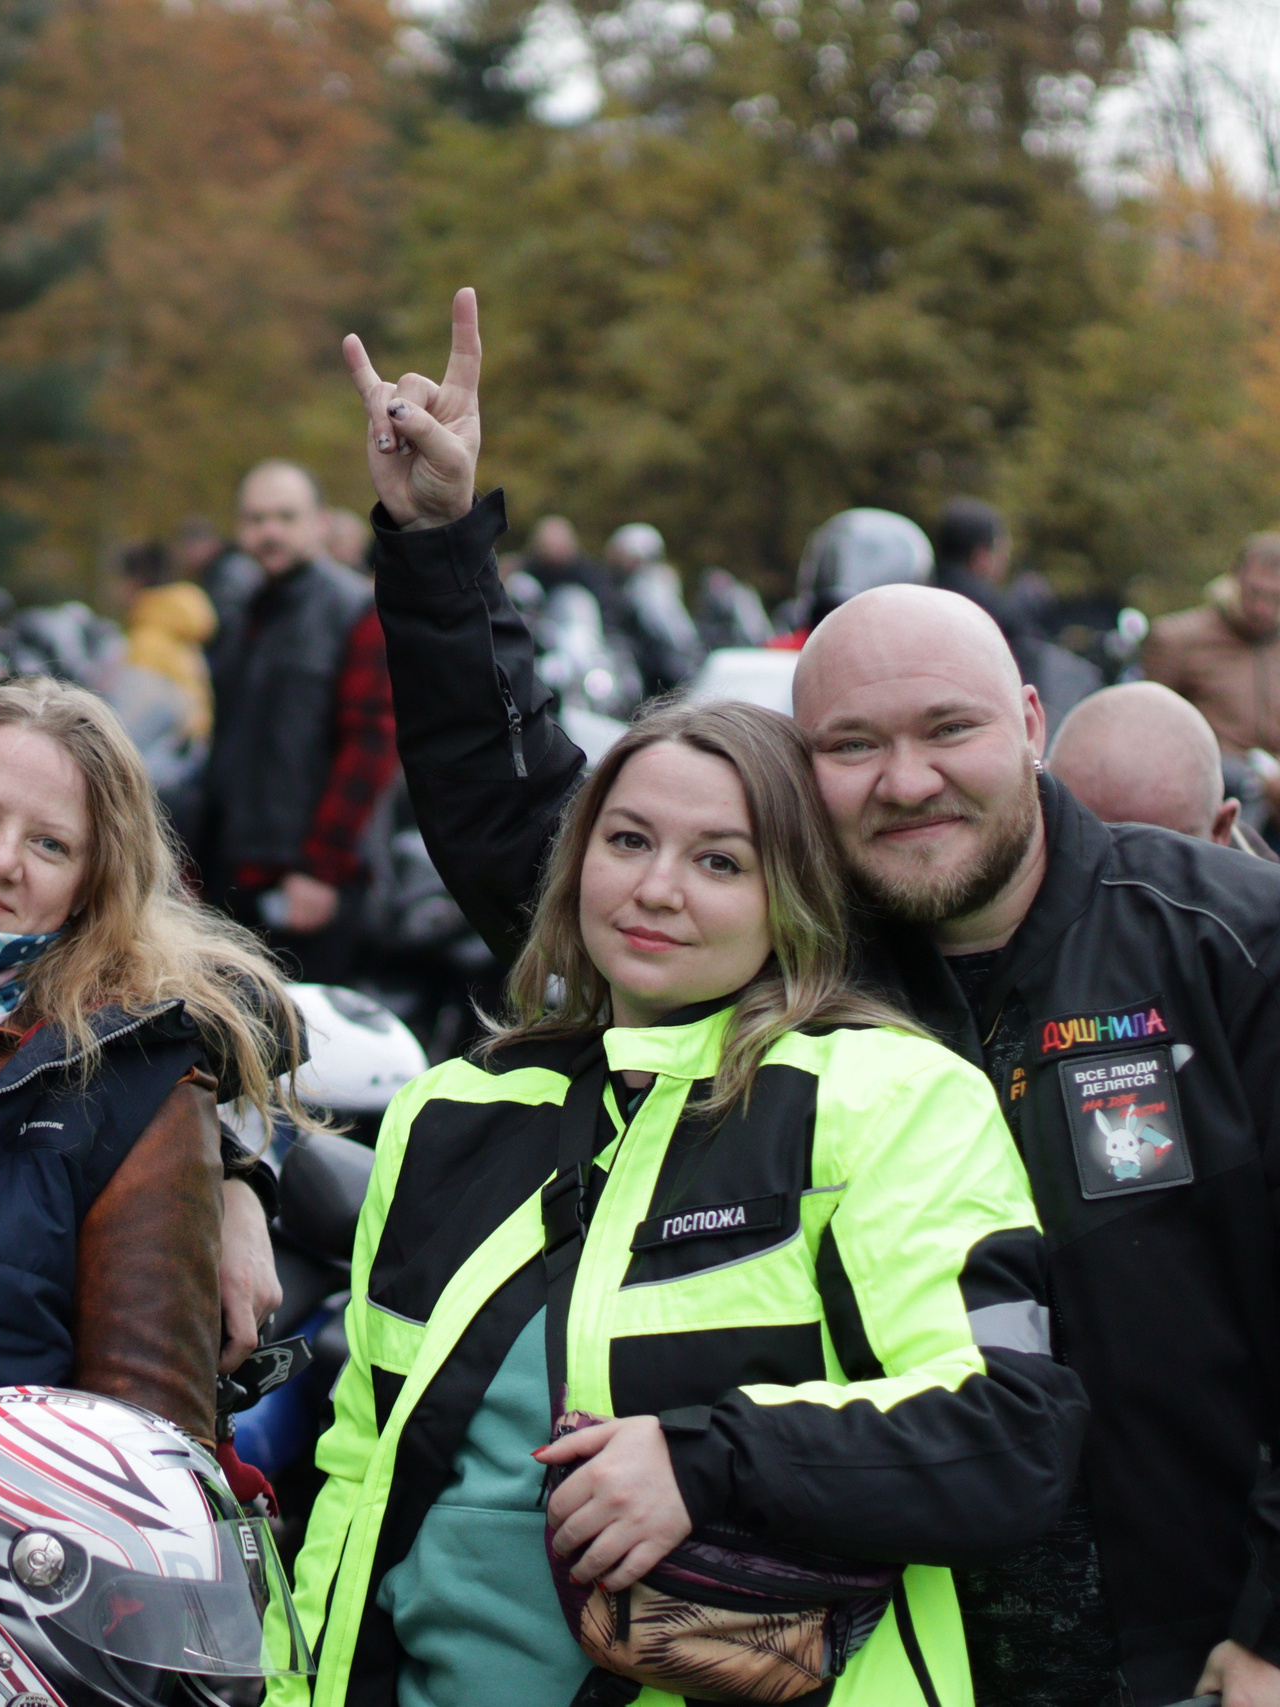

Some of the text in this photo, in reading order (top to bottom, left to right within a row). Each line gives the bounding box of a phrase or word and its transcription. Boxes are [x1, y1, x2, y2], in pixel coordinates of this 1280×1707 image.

[1041, 1008, 1167, 1053] ДУШНИЛА
[1074, 1059, 1159, 1084] ВСЕ ЛЮДИ
[1082, 1074, 1156, 1097] ДЕЛЯТСЯ
[662, 1206, 746, 1241] ГОСПОЖА
